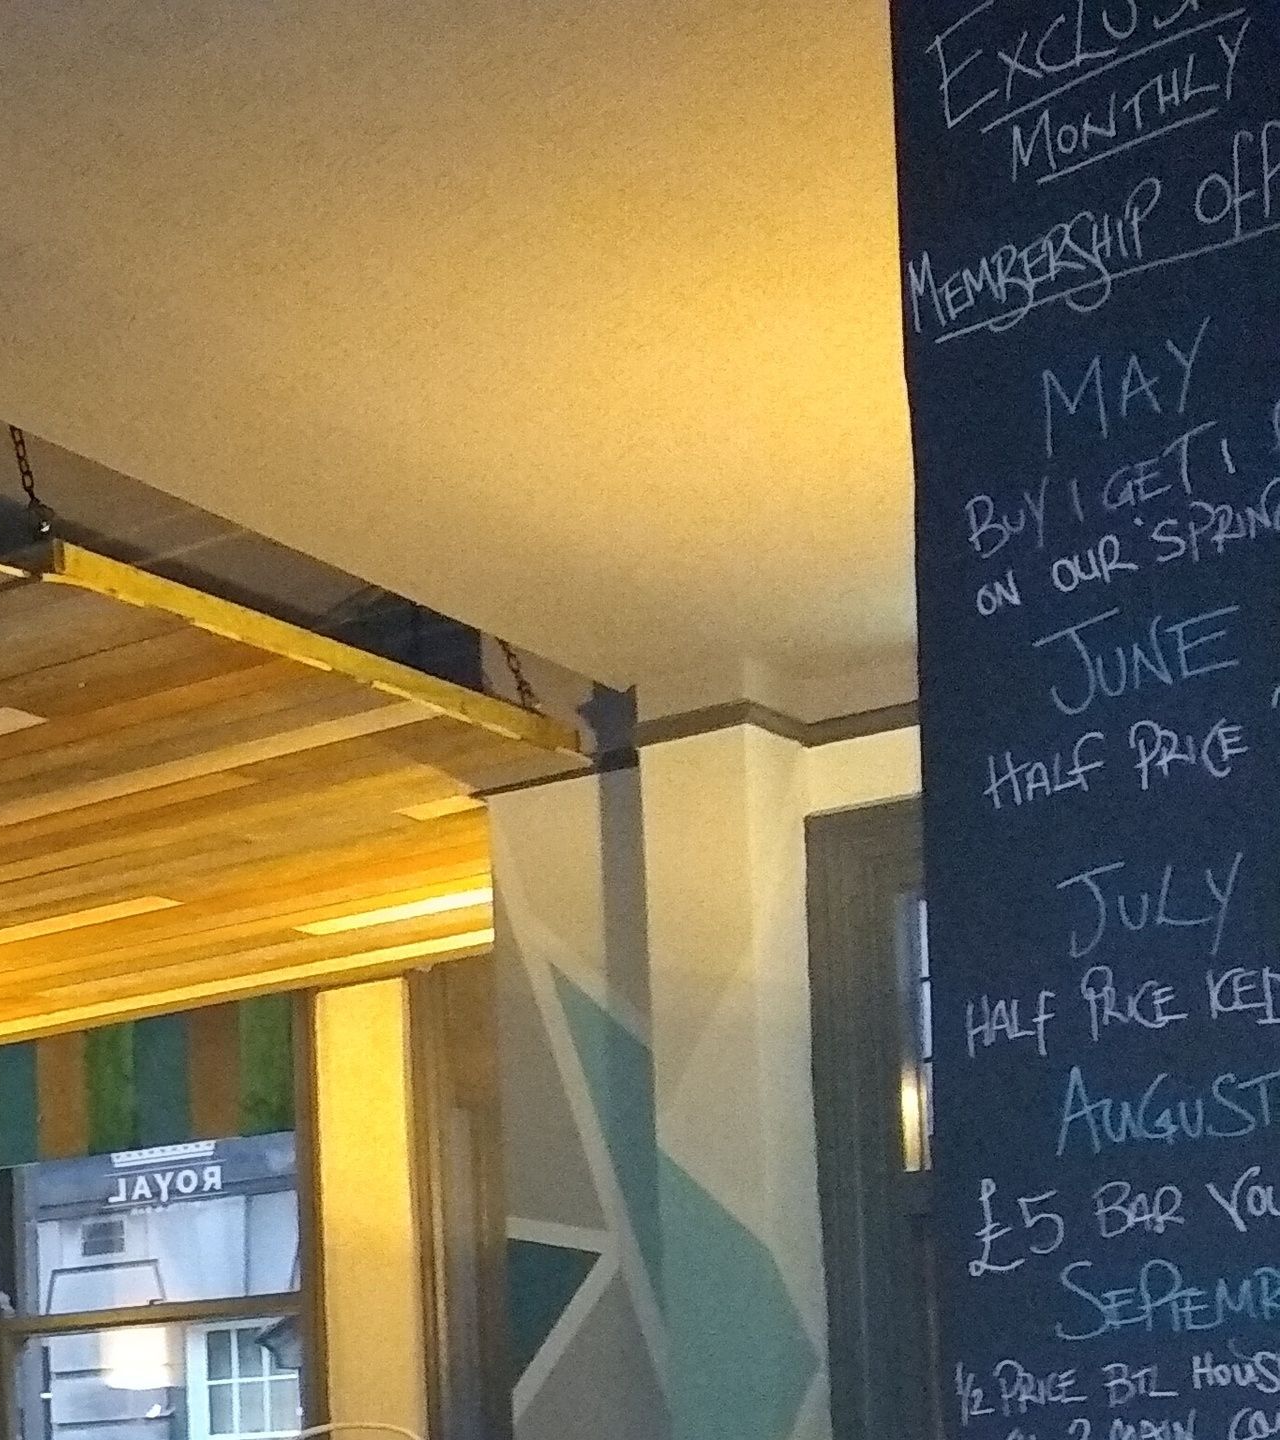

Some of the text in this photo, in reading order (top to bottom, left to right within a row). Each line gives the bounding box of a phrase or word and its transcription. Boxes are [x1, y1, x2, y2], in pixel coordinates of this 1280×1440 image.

[926, 0, 1202, 129] EXCLU
[1011, 17, 1252, 182] MONTHLY
[907, 176, 1162, 333] MEMBERSHIP
[1042, 315, 1211, 458] MAY
[964, 476, 1049, 559] BUY
[1101, 420, 1219, 510] GET
[976, 569, 1022, 616] ON
[1051, 534, 1140, 592] OUR
[1031, 605, 1240, 715] JUNE
[982, 718, 1250, 809] HALF PRICE
[1056, 851, 1244, 957] JULY
[966, 989, 1057, 1058] HALF
[1080, 965, 1190, 1042] PRICE
[1055, 1065, 1280, 1157] AUGUST
[967, 1178, 1066, 1277] £5
[1092, 1180, 1186, 1239] BAR
